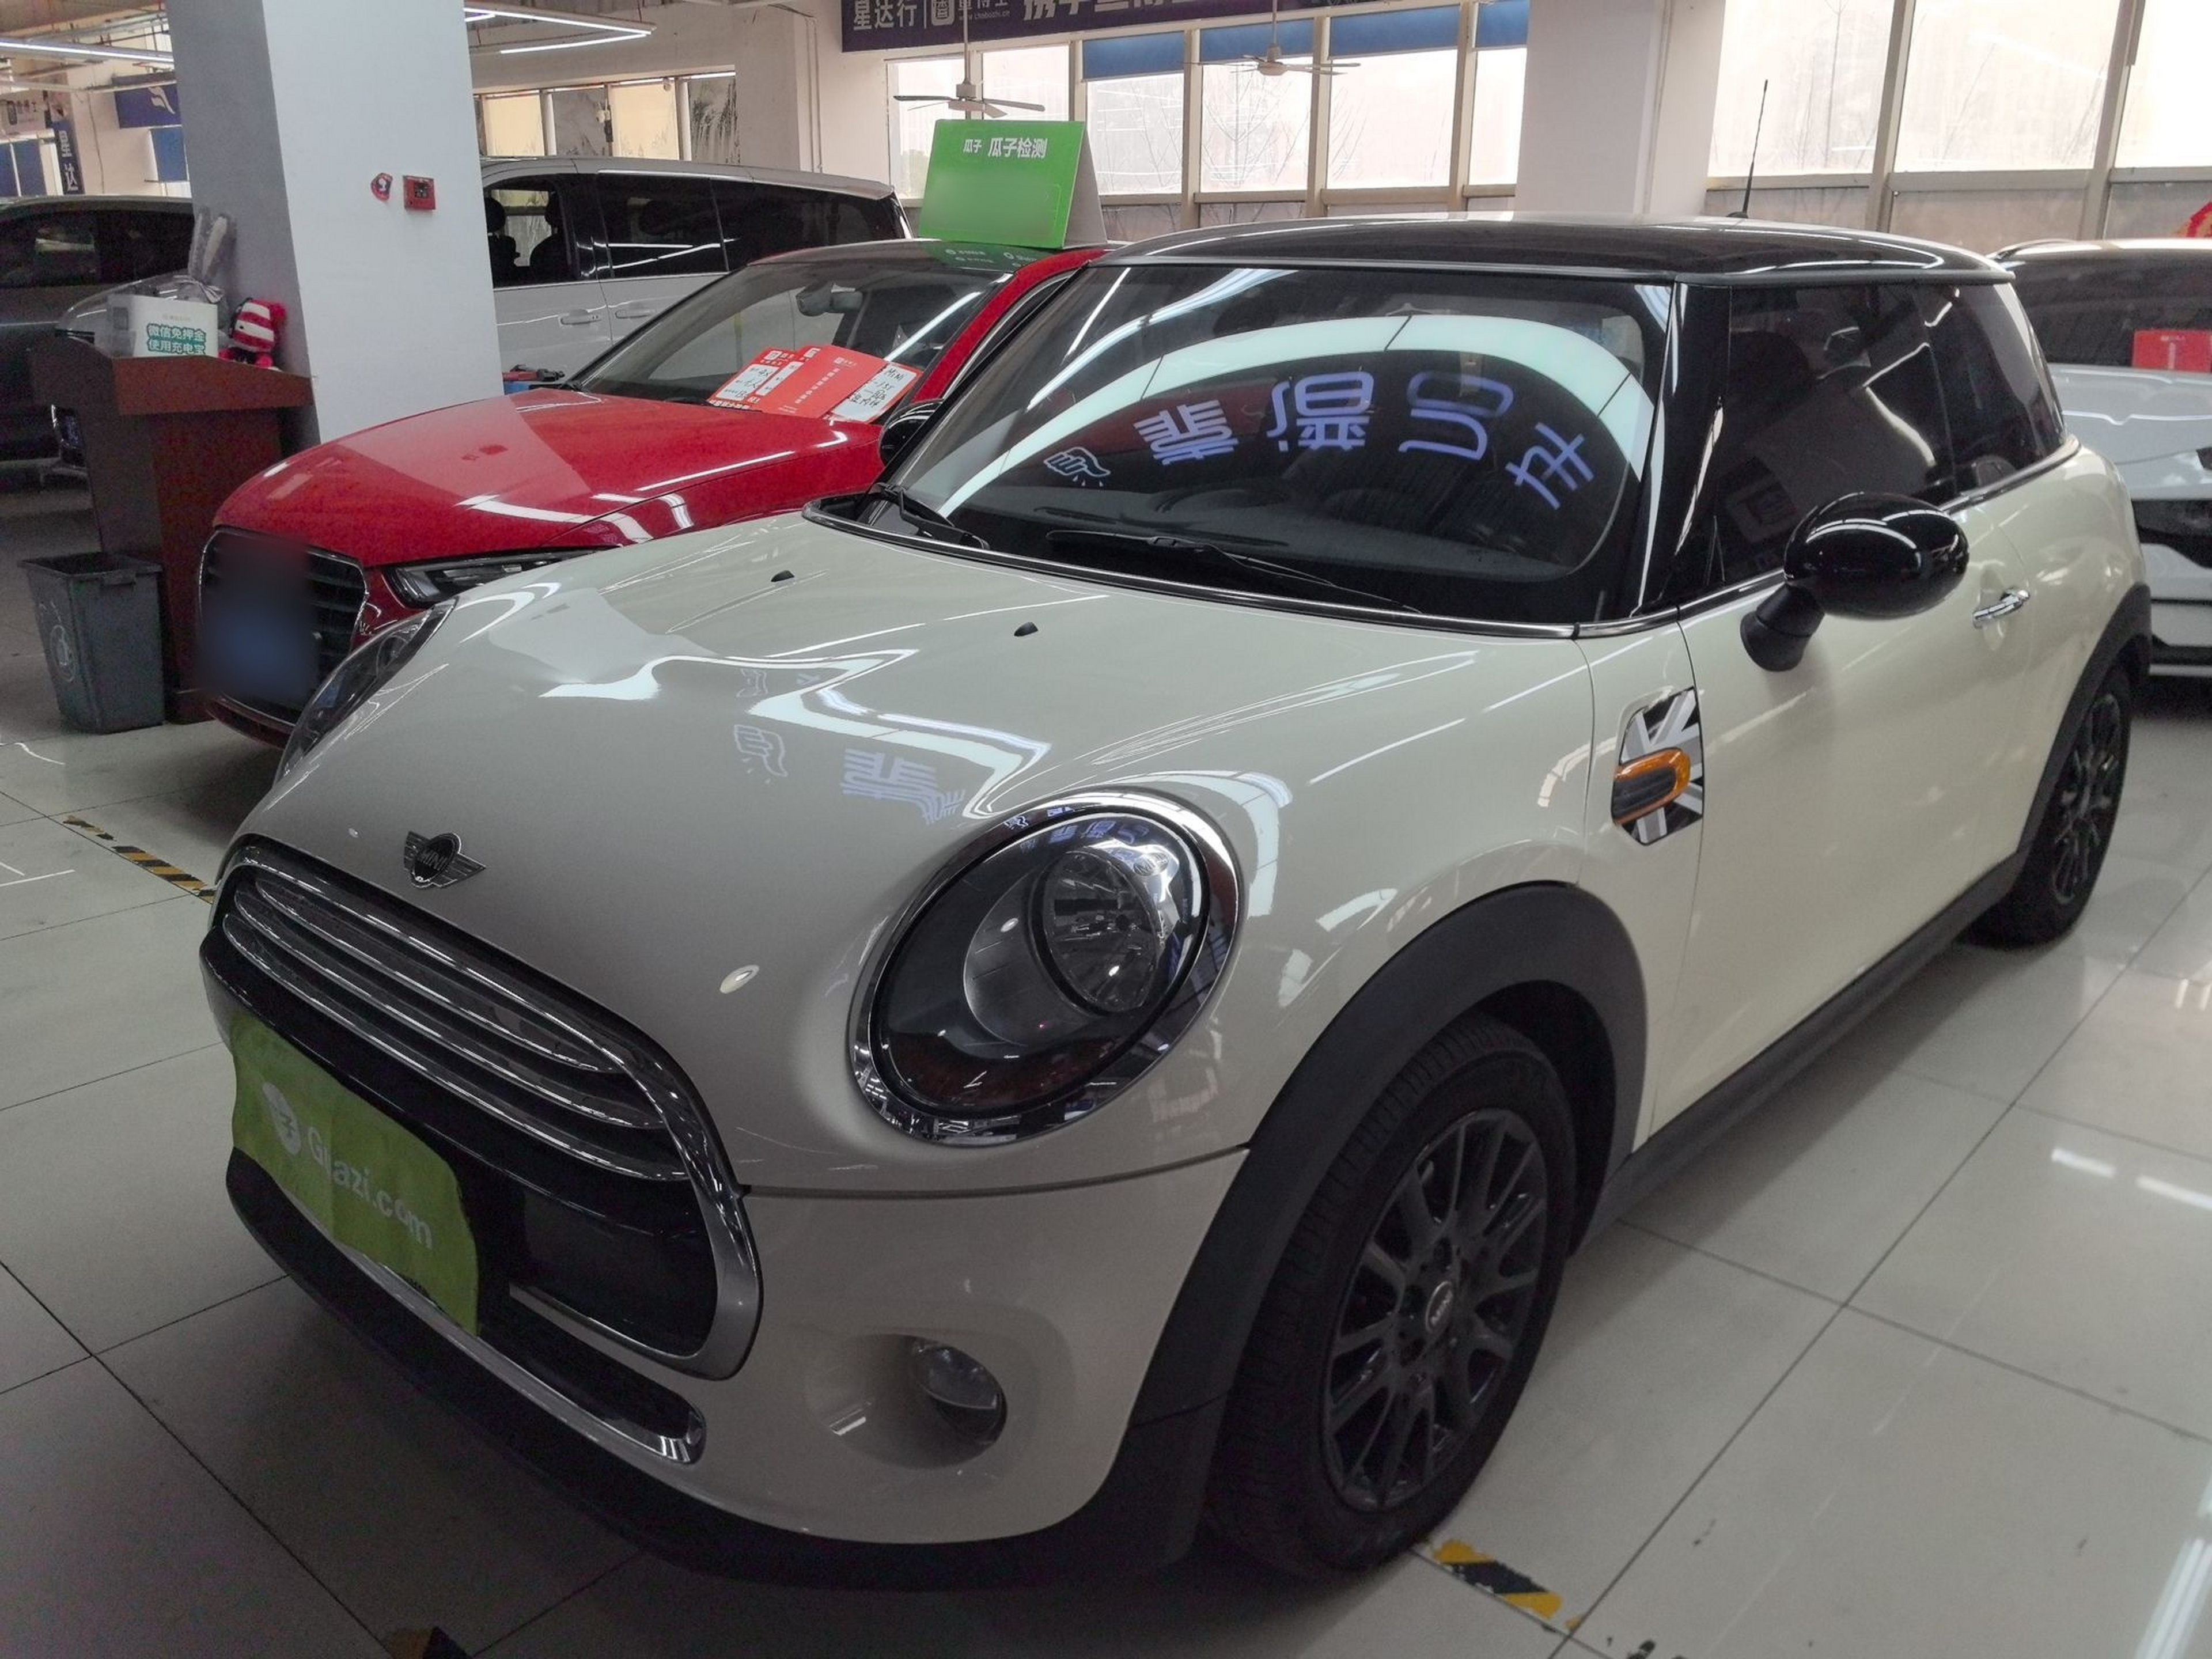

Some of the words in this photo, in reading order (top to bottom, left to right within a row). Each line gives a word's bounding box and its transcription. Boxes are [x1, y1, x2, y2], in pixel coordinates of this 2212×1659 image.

[963, 139, 982, 153] 瓜子
[987, 138, 1048, 159] 瓜子检测
[147, 324, 206, 342] 微信免押金
[148, 339, 206, 355] 使用充电宝
